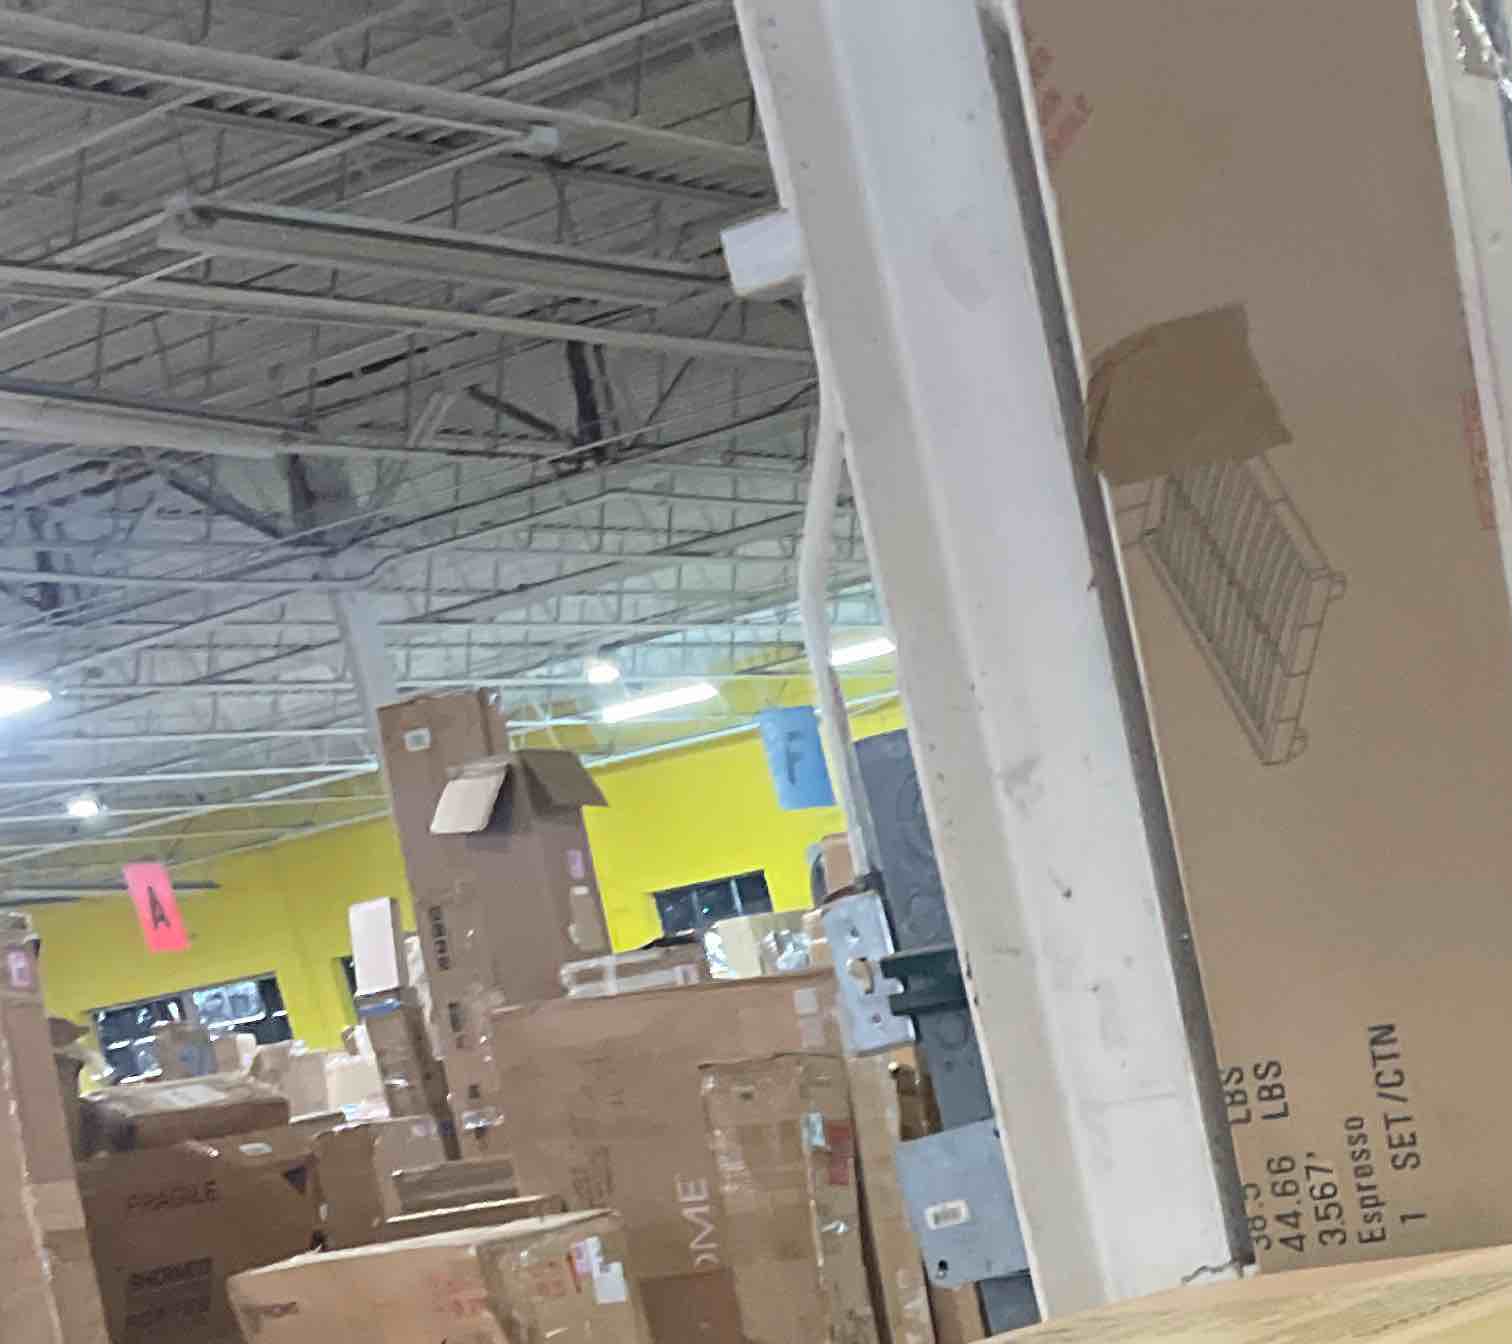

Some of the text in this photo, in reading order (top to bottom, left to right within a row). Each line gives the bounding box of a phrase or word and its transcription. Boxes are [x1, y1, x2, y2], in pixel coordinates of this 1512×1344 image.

[147, 886, 171, 929] A
[1223, 1066, 1252, 1125] LBS
[1253, 1059, 1306, 1253] 44.66 LBS
[1345, 1115, 1388, 1244] Espresso
[1400, 1210, 1428, 1224] 1
